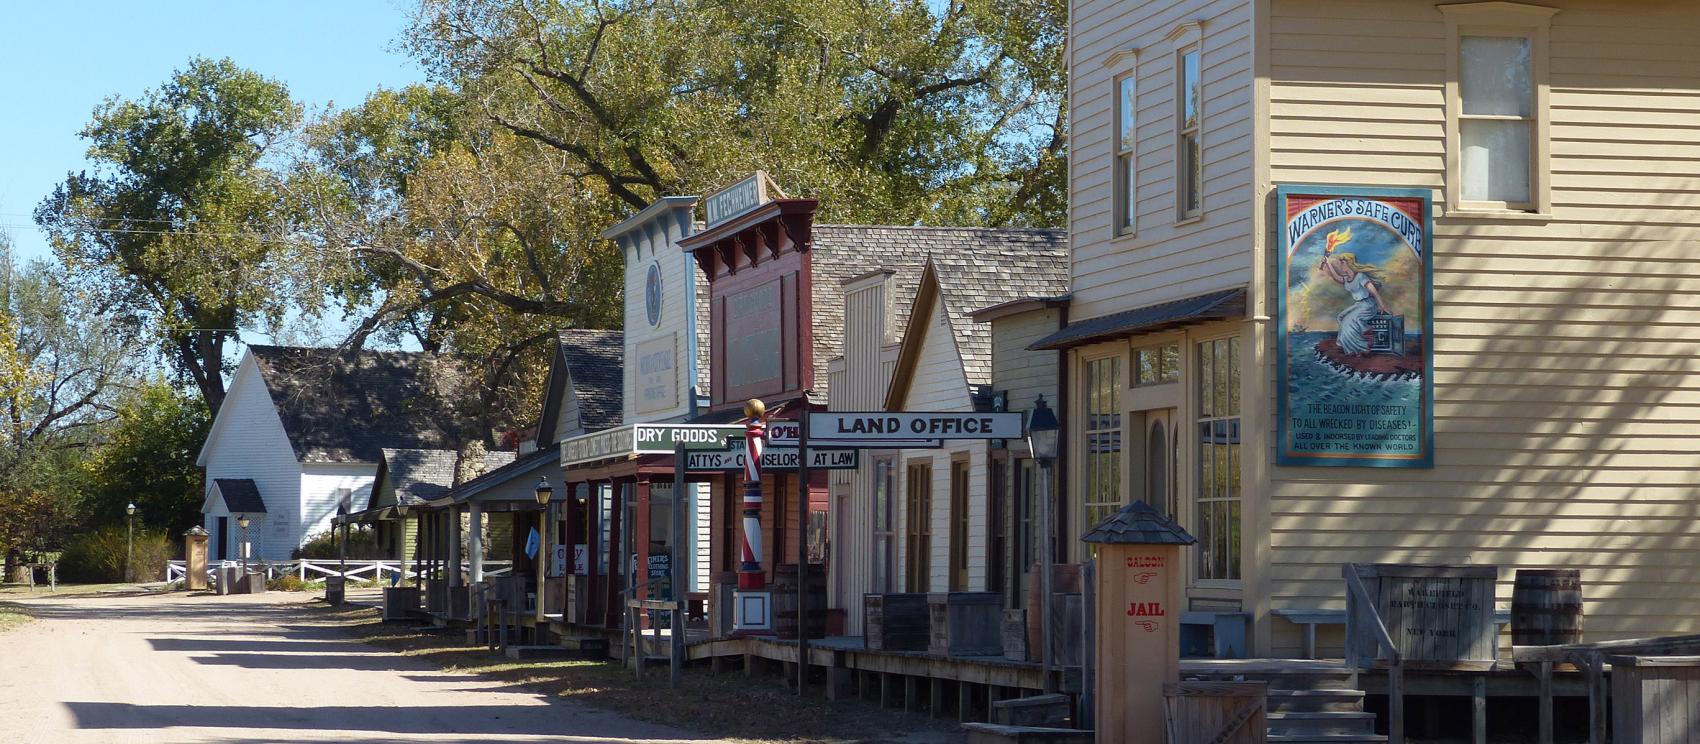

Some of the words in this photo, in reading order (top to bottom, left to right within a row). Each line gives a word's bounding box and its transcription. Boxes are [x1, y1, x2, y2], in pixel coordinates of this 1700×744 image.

[1289, 199, 1352, 246] WARNER'S
[1355, 199, 1389, 221] SAFE
[1391, 211, 1421, 257] CURE
[1307, 403, 1322, 414] THE
[1323, 404, 1350, 415] BEACON
[1351, 404, 1370, 415] LIGHT
[1371, 405, 1380, 415] OF
[1381, 405, 1407, 416] SAFETY
[838, 418, 900, 434] LAND
[910, 417, 993, 434] OFFICE
[1293, 418, 1302, 429] TO
[1304, 418, 1318, 429] ALL
[1319, 418, 1353, 429] WRECKED
[1356, 419, 1367, 430] BY
[638, 428, 665, 442] DRY
[671, 429, 718, 443] GOODS
[1295, 432, 1313, 440] USED
[1389, 434, 1416, 442] DOCTORS
[1334, 443, 1350, 451] THE
[1384, 443, 1414, 451] WORLD
[689, 453, 721, 467] ATTYS
[814, 453, 827, 465] AT
[831, 453, 854, 465] LAW
[1127, 556, 1164, 568] SALOON
[1127, 602, 1165, 616] JAIL
